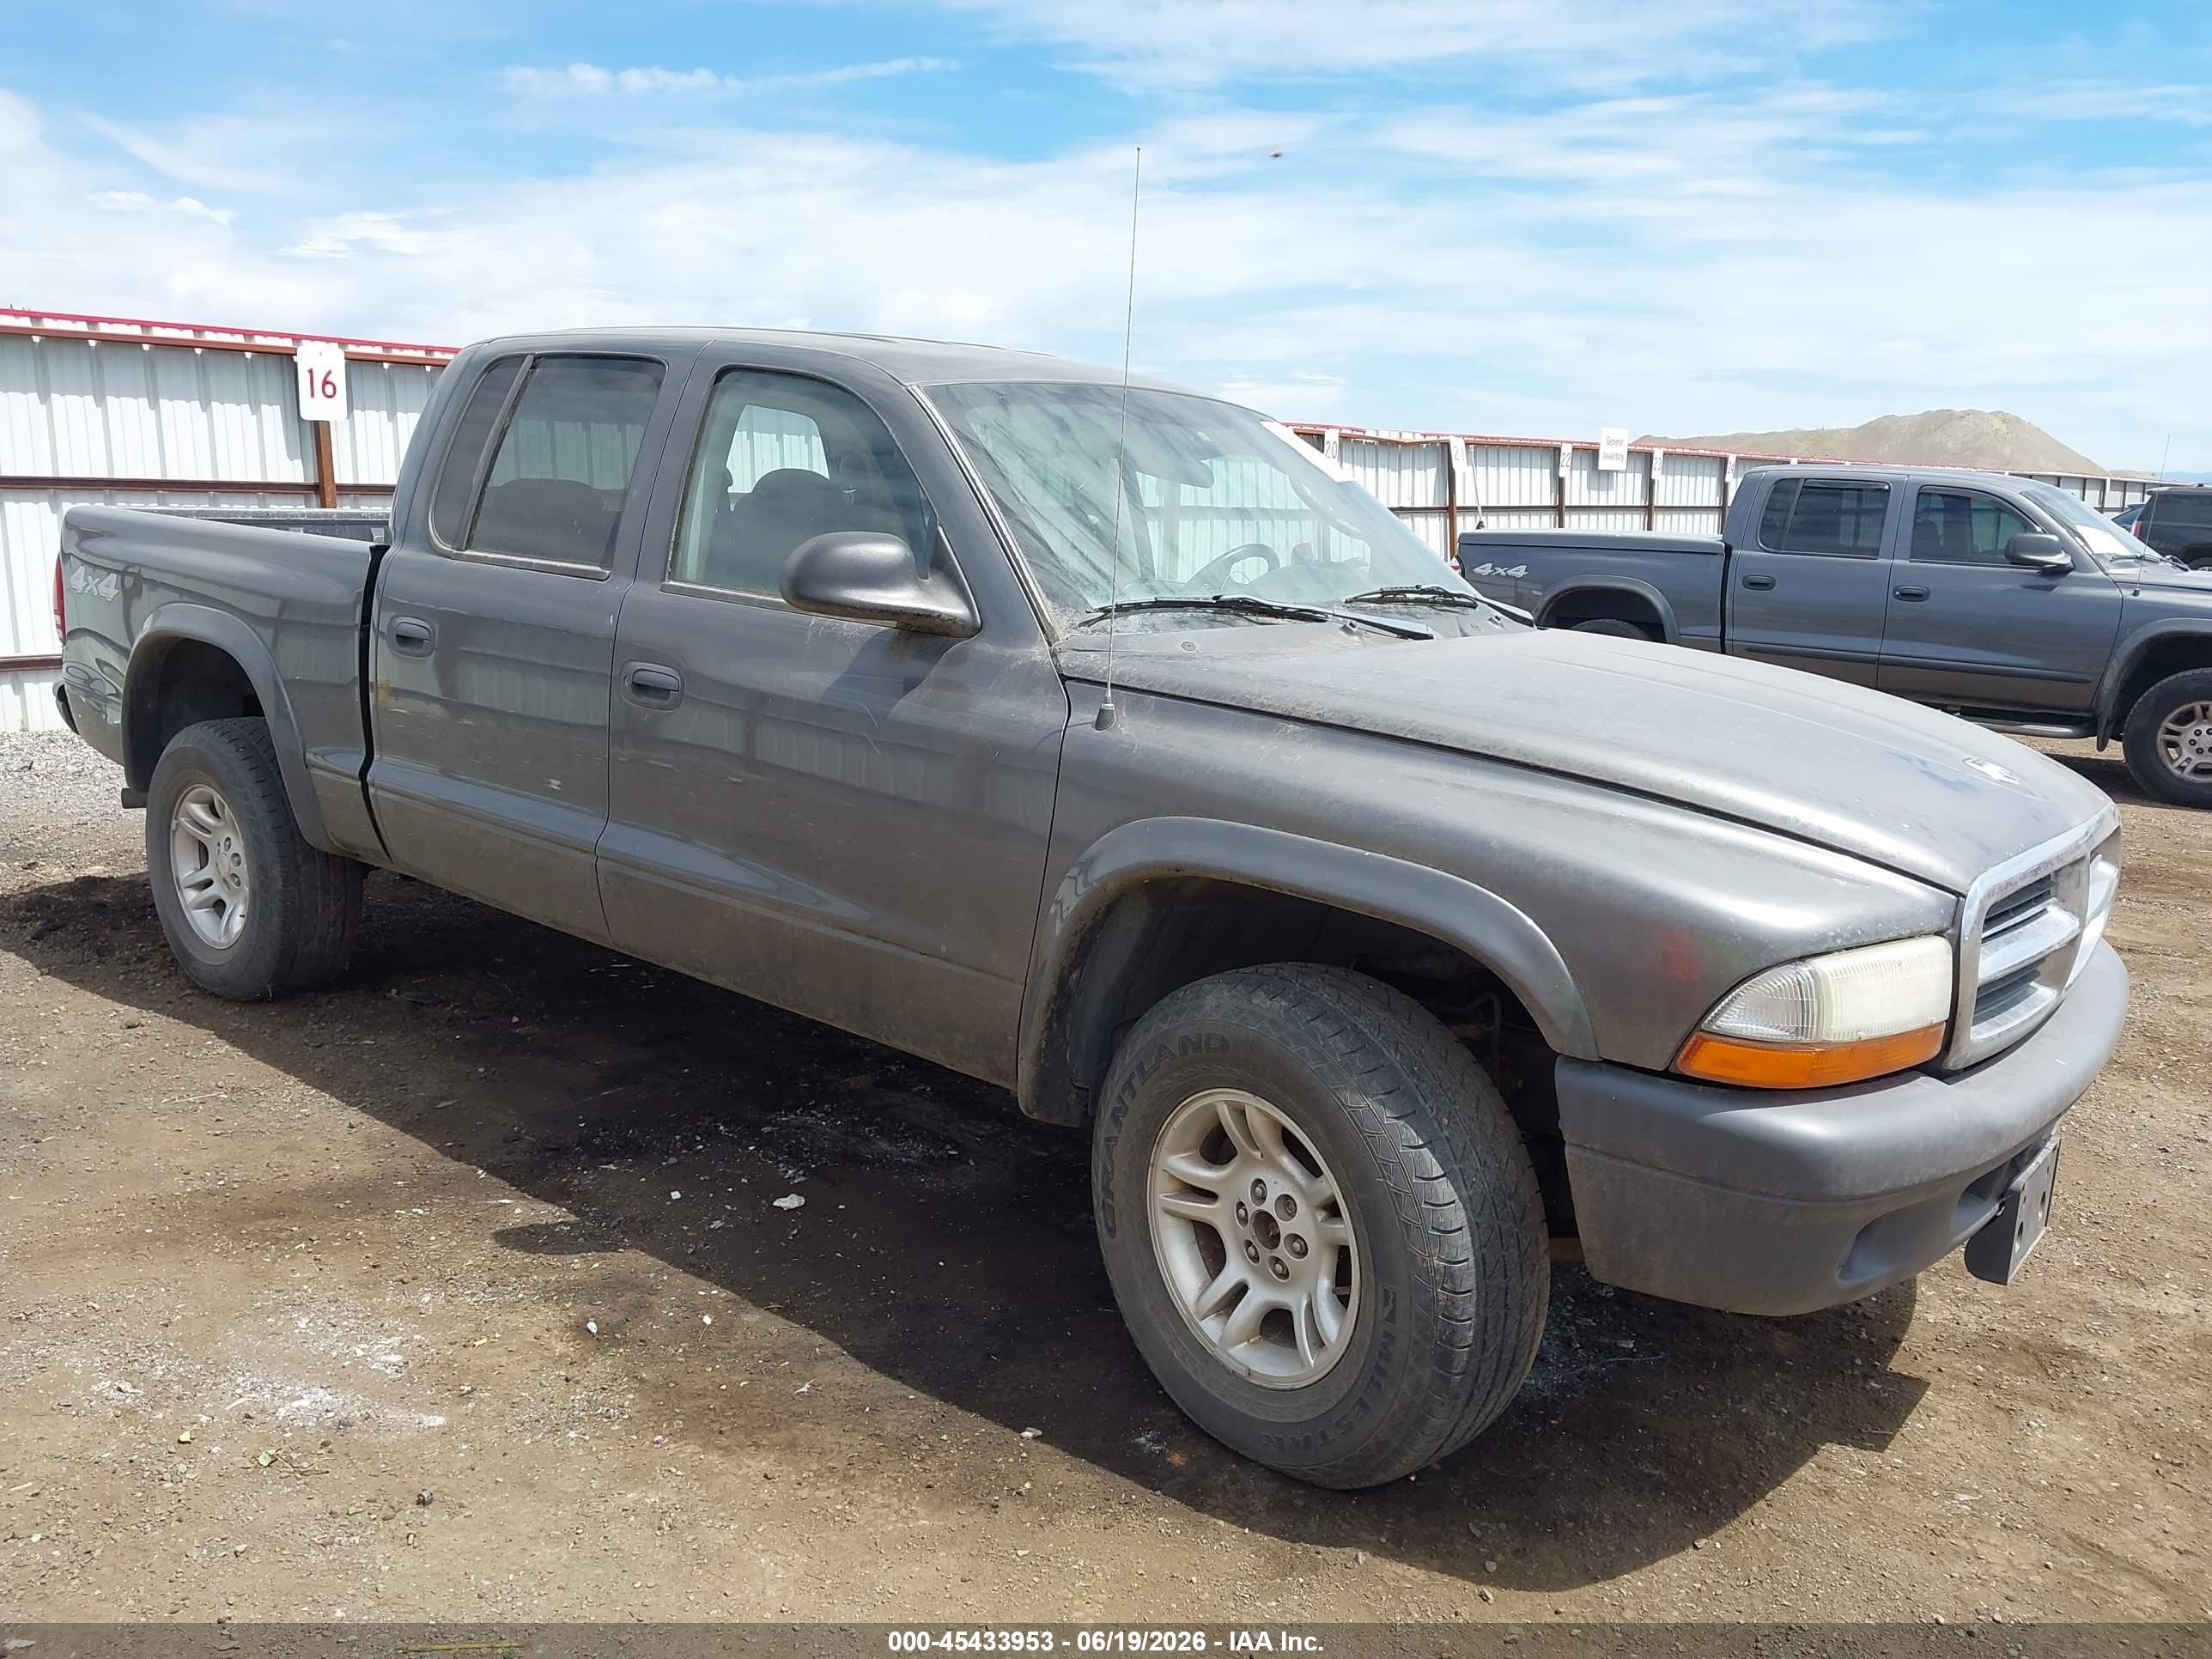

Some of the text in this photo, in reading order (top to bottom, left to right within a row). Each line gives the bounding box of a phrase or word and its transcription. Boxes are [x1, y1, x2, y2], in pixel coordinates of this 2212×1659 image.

[307, 368, 337, 398] 16
[1325, 441, 1338, 459] 20
[1454, 446, 1465, 462] 21
[1560, 453, 1571, 468] 22
[1653, 457, 1662, 471] 23
[1473, 562, 1528, 577] 4x4
[70, 566, 118, 601] 4x4
[1101, 1033, 1230, 1238] GRANTLAND
